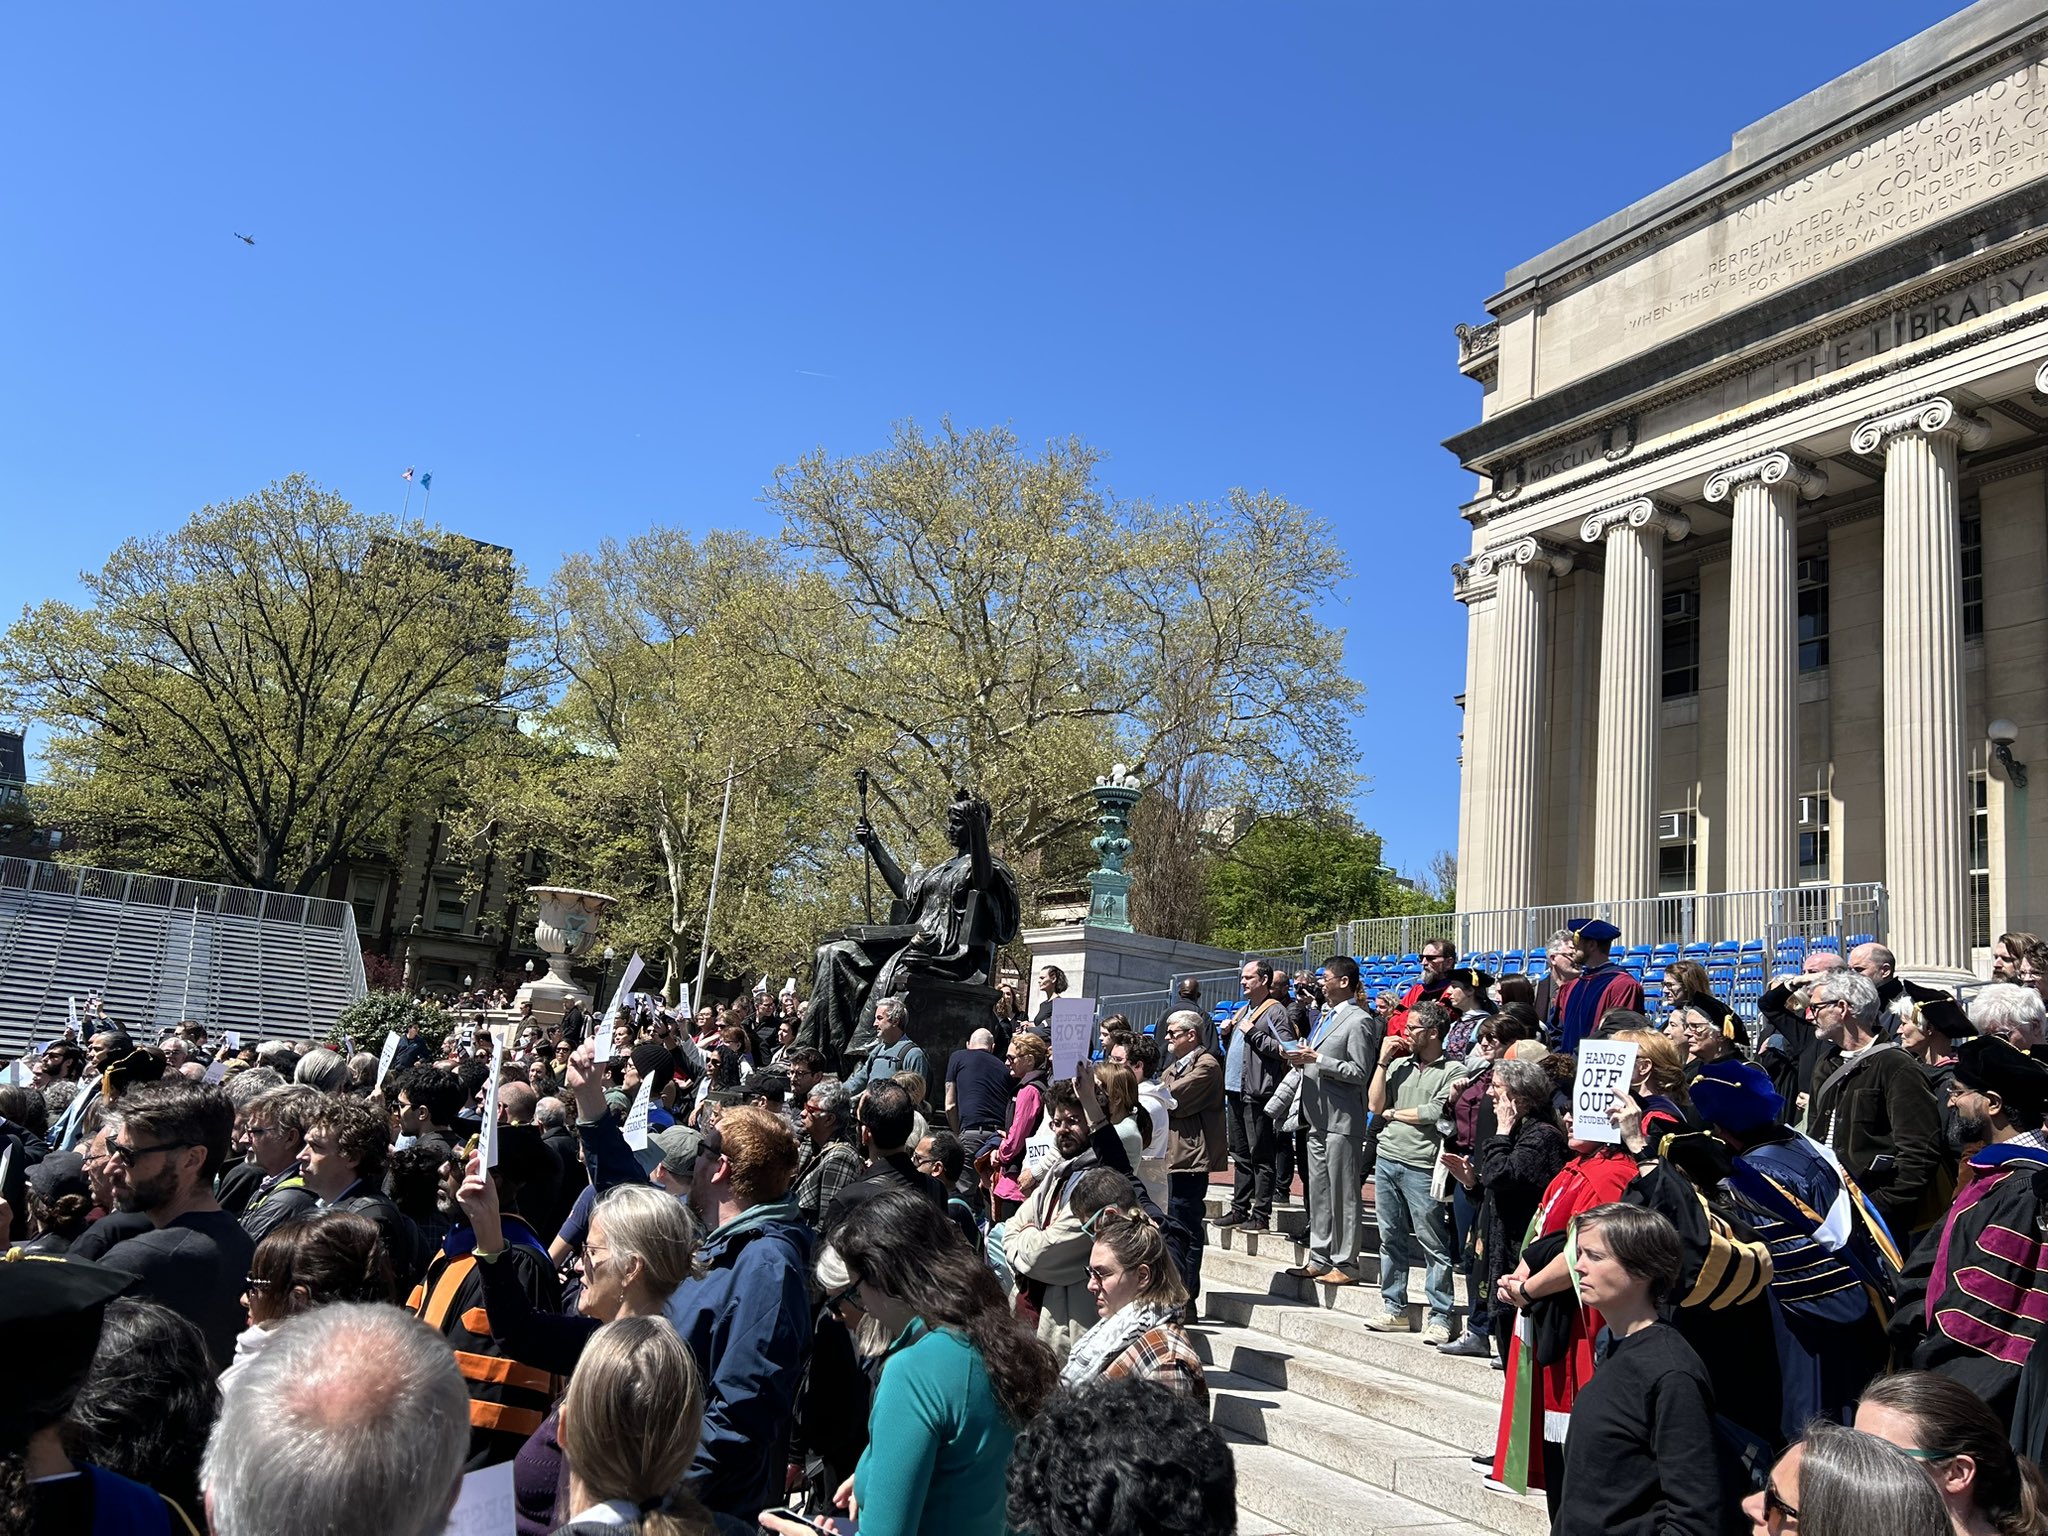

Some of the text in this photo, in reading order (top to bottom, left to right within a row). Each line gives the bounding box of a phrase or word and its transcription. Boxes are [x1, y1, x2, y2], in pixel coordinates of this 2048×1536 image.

[1828, 110, 1954, 179] COLLEGE
[1895, 144, 1921, 169] BY
[1933, 109, 2002, 152] ROYAL
[1629, 128, 2048, 328] WHEN THEY BECAME FREE AND INDEPENDENT
[1708, 209, 1833, 279] PERPETUATED
[1842, 192, 1867, 217] AS
[1876, 125, 2012, 197] COLUMBIA
[1748, 272, 1780, 296] FOR
[1788, 252, 1823, 278] THE
[1832, 182, 1977, 258] ADVANCEMENT
[1987, 166, 2015, 188] OF
[1786, 269, 2034, 387] THE LIBRARY
[1529, 443, 1598, 483] MDCCLIV
[1582, 1068, 1623, 1088] OFF
[1585, 1052, 1626, 1066] HANDS
[1579, 1091, 1615, 1112] OUR
[1579, 1115, 1610, 1126] STUDENT
